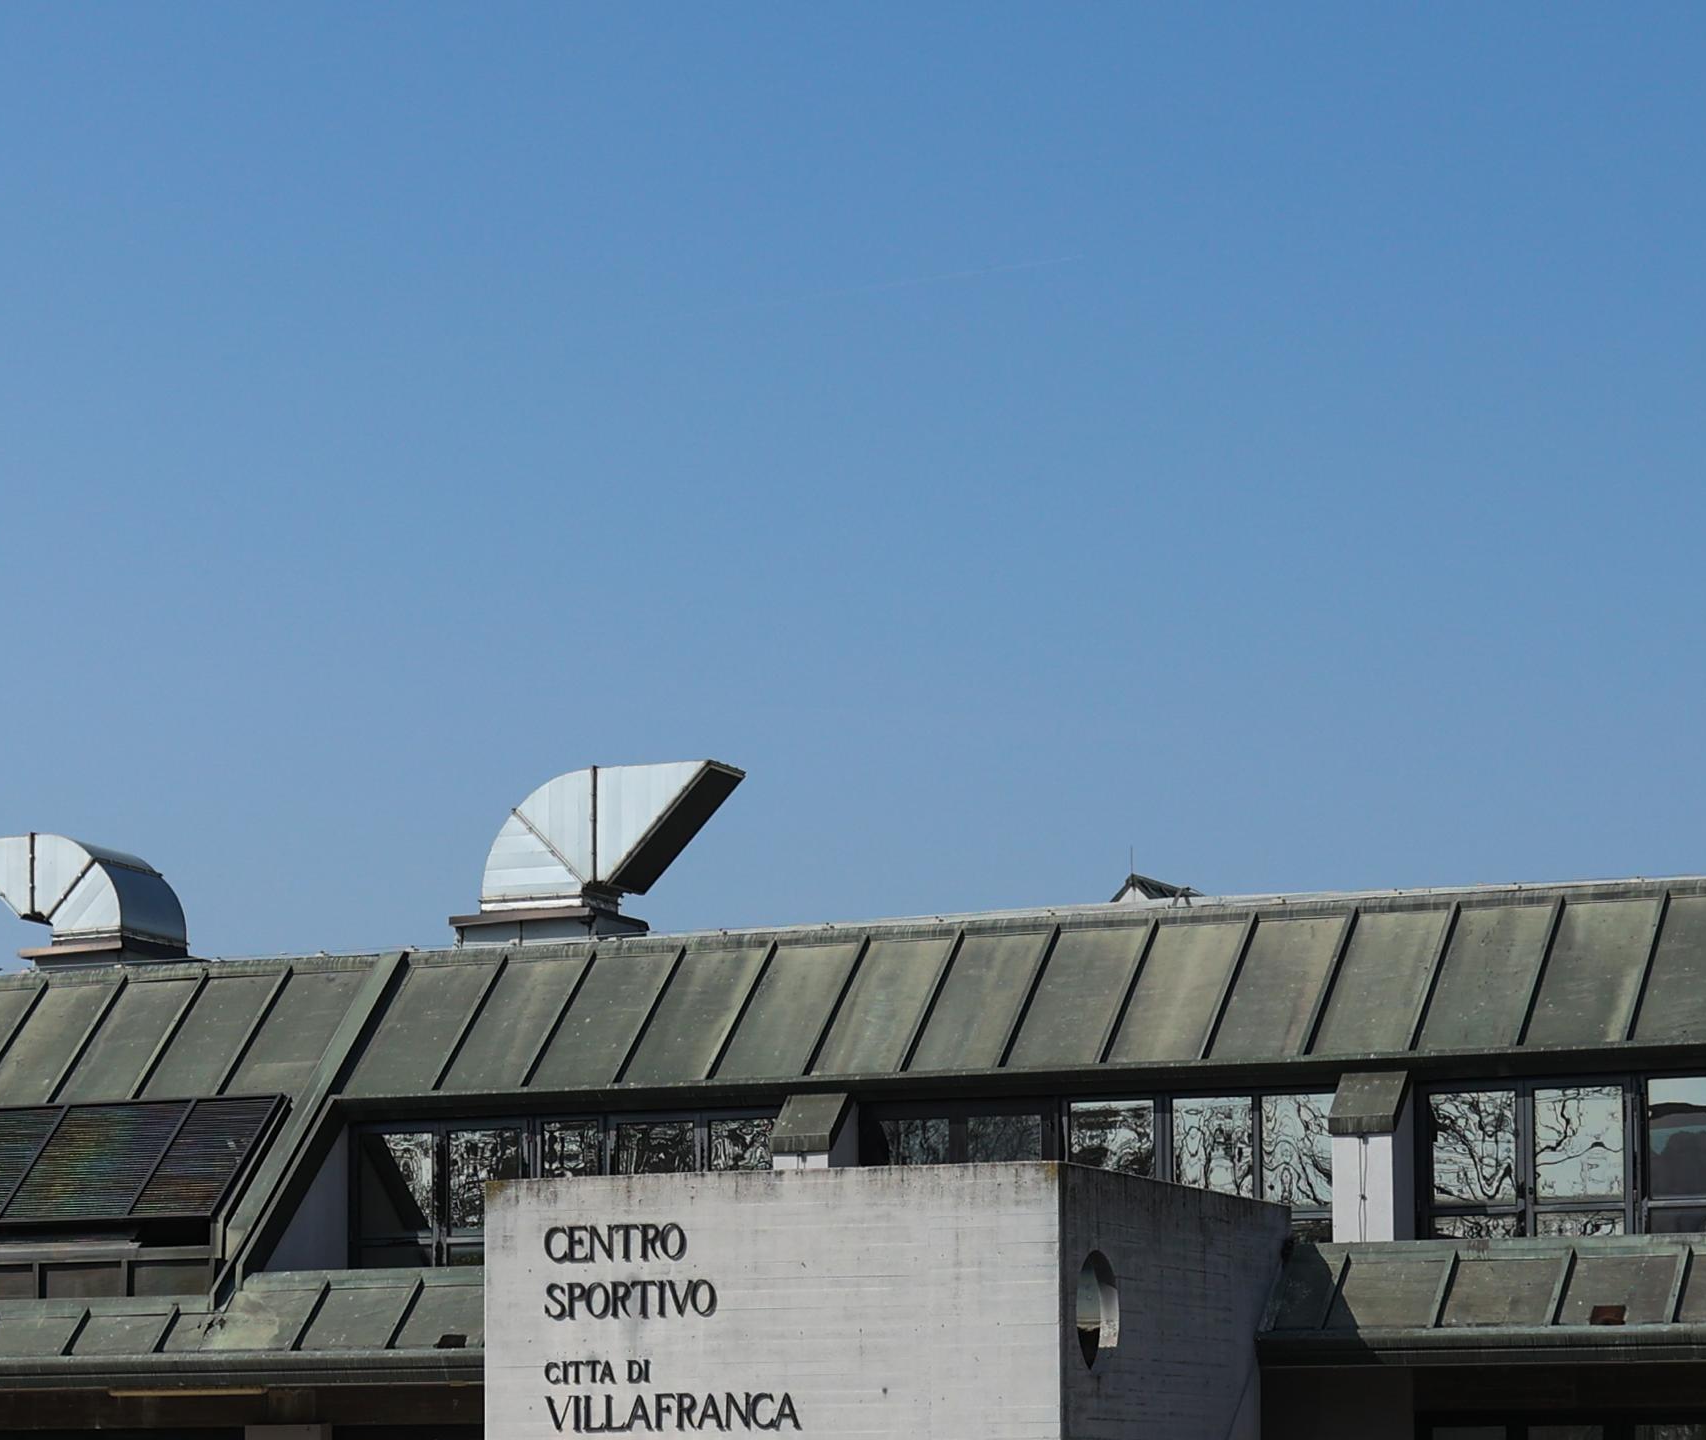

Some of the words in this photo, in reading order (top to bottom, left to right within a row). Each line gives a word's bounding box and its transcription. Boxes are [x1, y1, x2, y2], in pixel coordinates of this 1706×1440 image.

[544, 1222, 687, 1263] CENTRO
[544, 1279, 718, 1321] SPORTIVO
[544, 1360, 617, 1385] CITTA
[626, 1359, 651, 1384] DI
[544, 1392, 802, 1433] VILLAFRANCA
